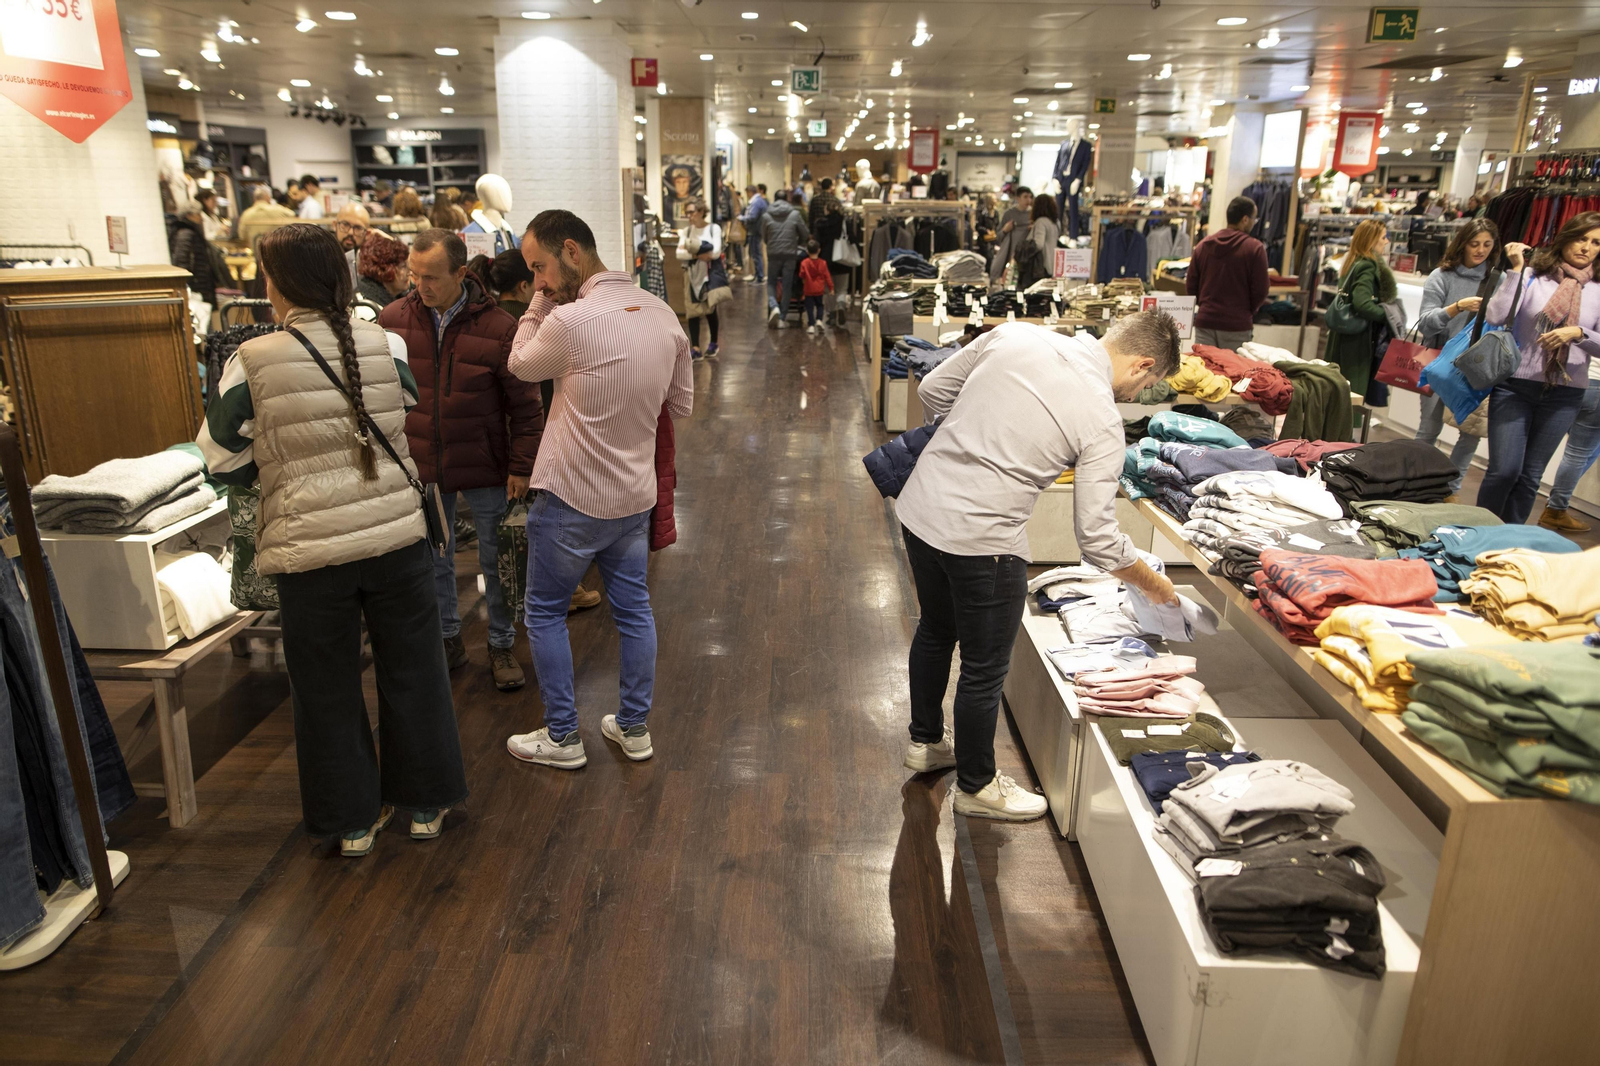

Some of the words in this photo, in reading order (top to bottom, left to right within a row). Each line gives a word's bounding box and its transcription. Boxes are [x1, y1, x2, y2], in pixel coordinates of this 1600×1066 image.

[5, 74, 26, 84] QUEDA
[26, 77, 62, 90] SATISFECHO,
[1568, 78, 1598, 95] EASY
